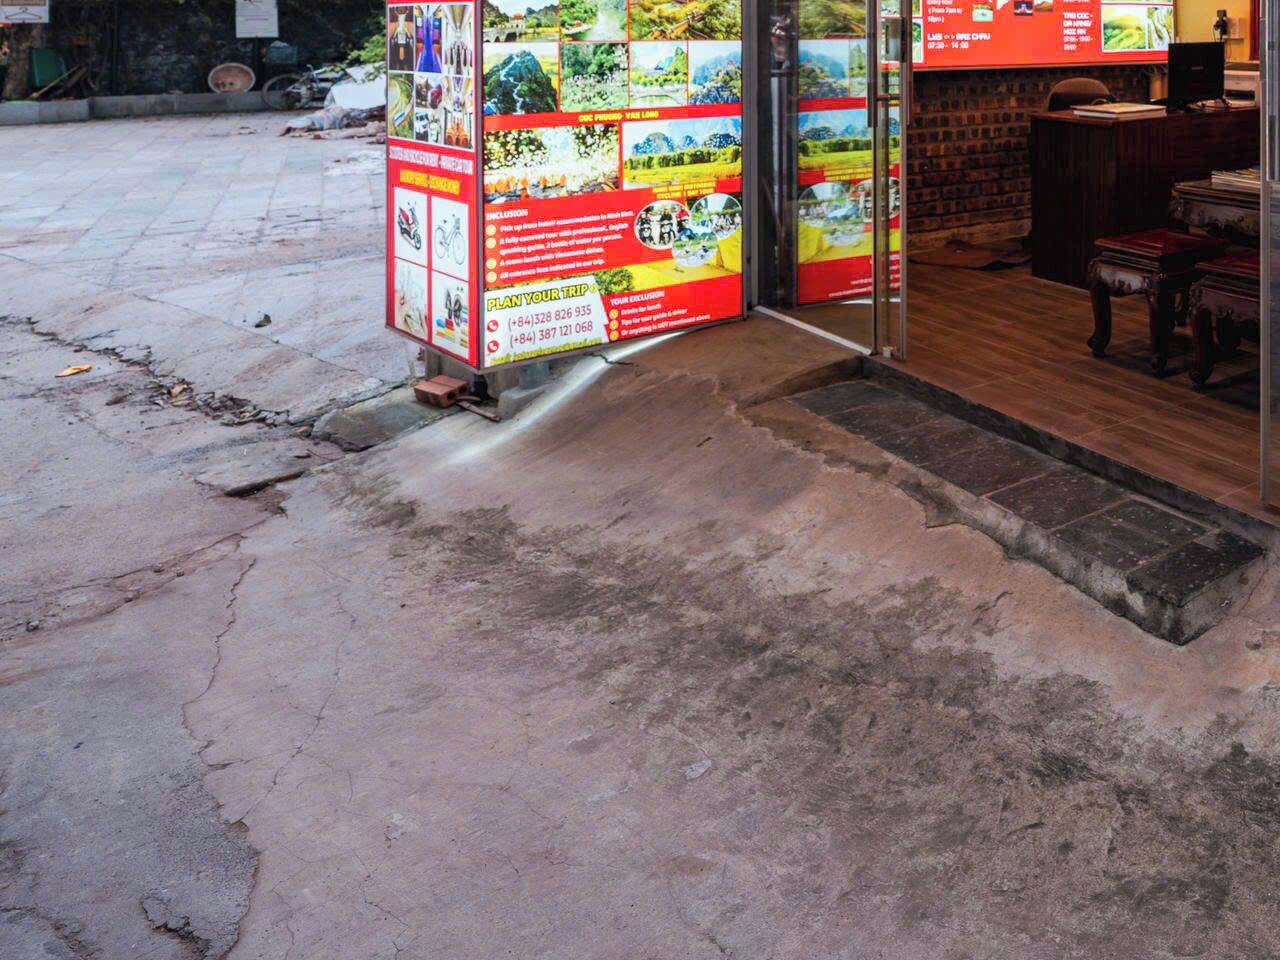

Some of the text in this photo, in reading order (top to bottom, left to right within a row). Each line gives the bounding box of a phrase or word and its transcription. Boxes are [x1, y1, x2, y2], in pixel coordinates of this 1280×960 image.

[485, 209, 528, 220] INCLUSION
[487, 283, 589, 311] PLAN YOUR TRIP
[507, 304, 592, 333] (+84)328 826 935
[509, 321, 593, 349] (+84) 387 121 068
